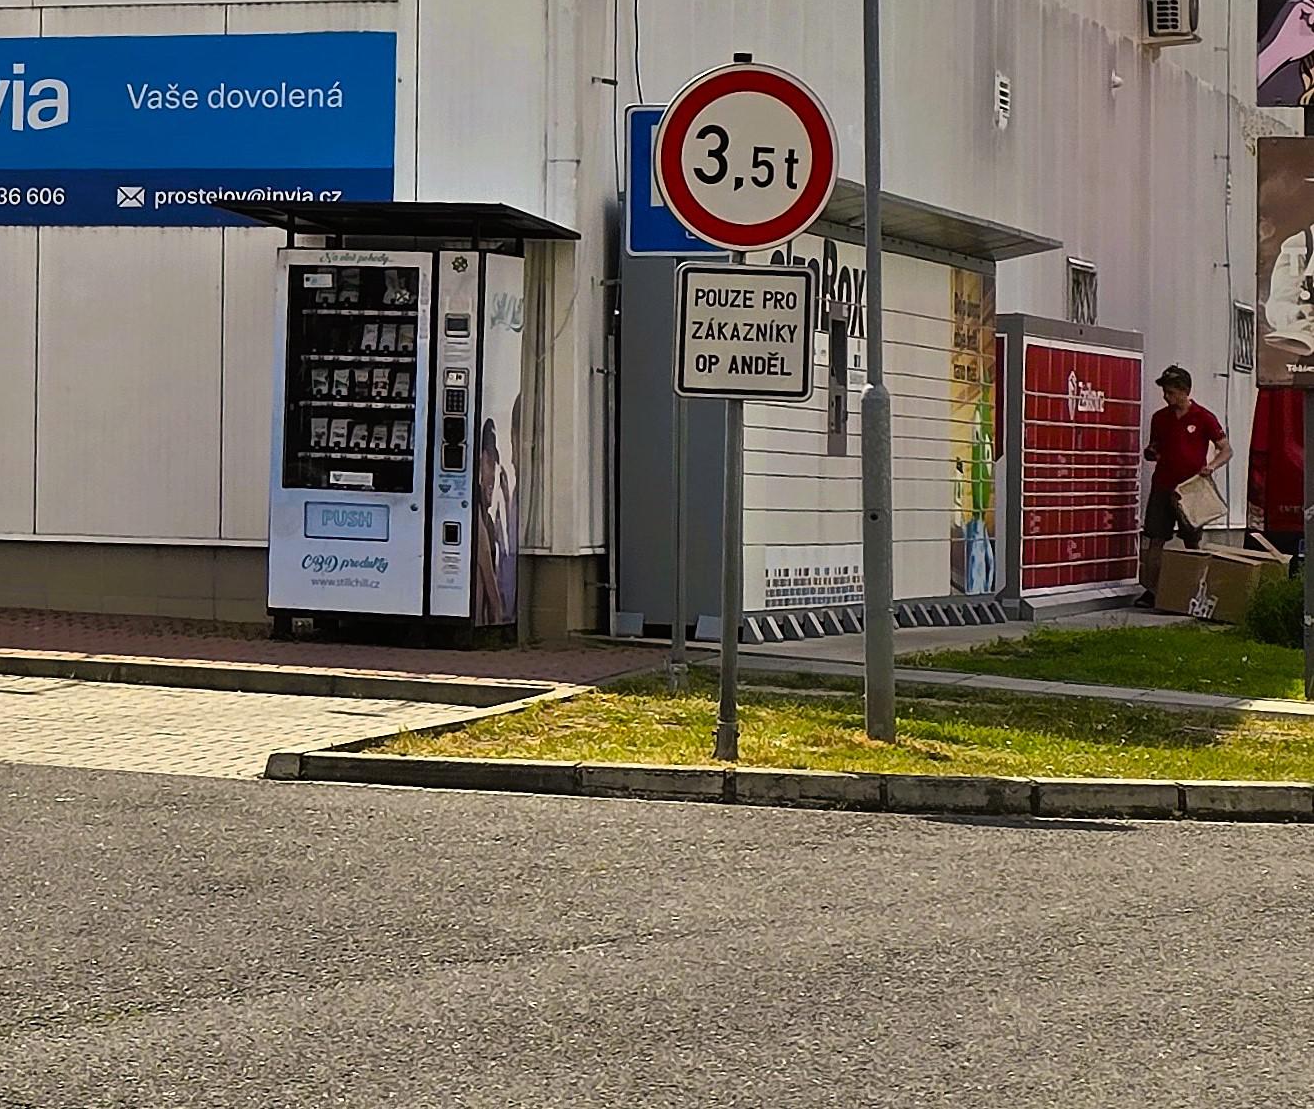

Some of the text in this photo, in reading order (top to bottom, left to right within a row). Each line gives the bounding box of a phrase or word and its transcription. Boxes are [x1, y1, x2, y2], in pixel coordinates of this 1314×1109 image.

[126, 81, 344, 109] Vaše dovolená
[26, 185, 66, 205] 606
[694, 289, 798, 310] POUZE PRO
[691, 317, 798, 343] ZÁKAZNÍKY
[695, 352, 792, 377] OP ANDĚL
[322, 509, 373, 528] PUSH
[301, 554, 338, 573] CBD
